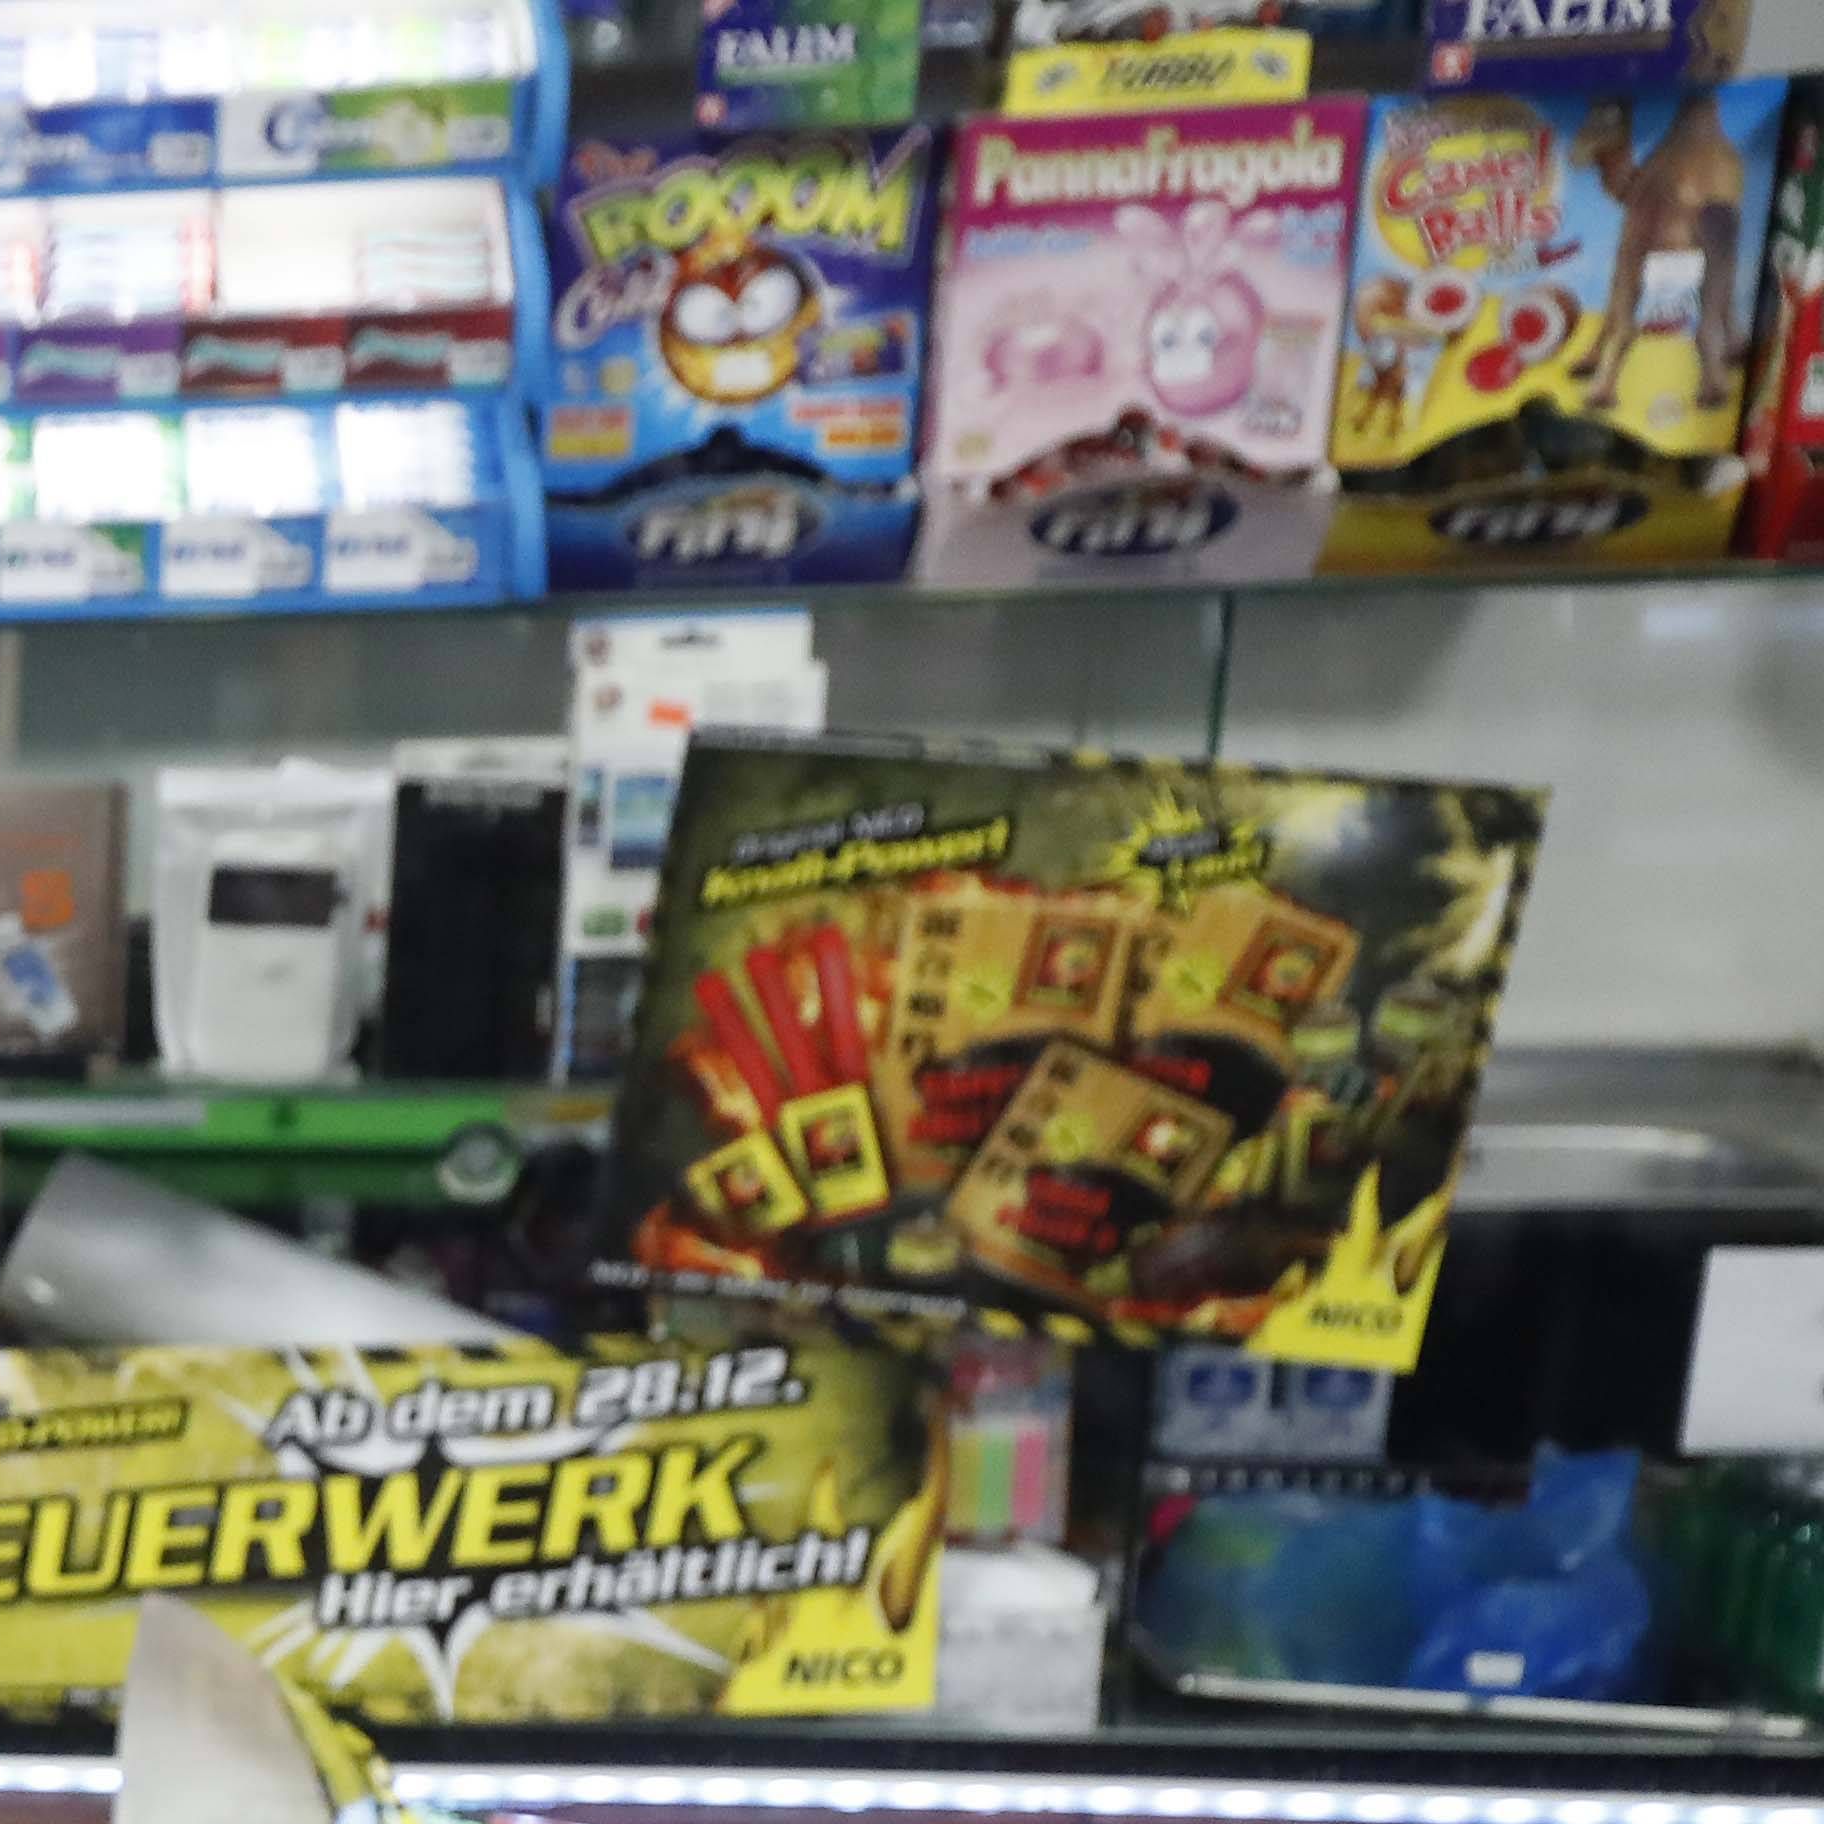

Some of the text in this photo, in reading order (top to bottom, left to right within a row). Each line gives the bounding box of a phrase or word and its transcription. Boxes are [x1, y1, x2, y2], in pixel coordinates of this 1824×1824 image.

[266, 1345, 809, 1450] Ab dem 28.12.
[317, 1527, 870, 1628] Hier erhältlich!
[780, 1648, 906, 1688] NICO
